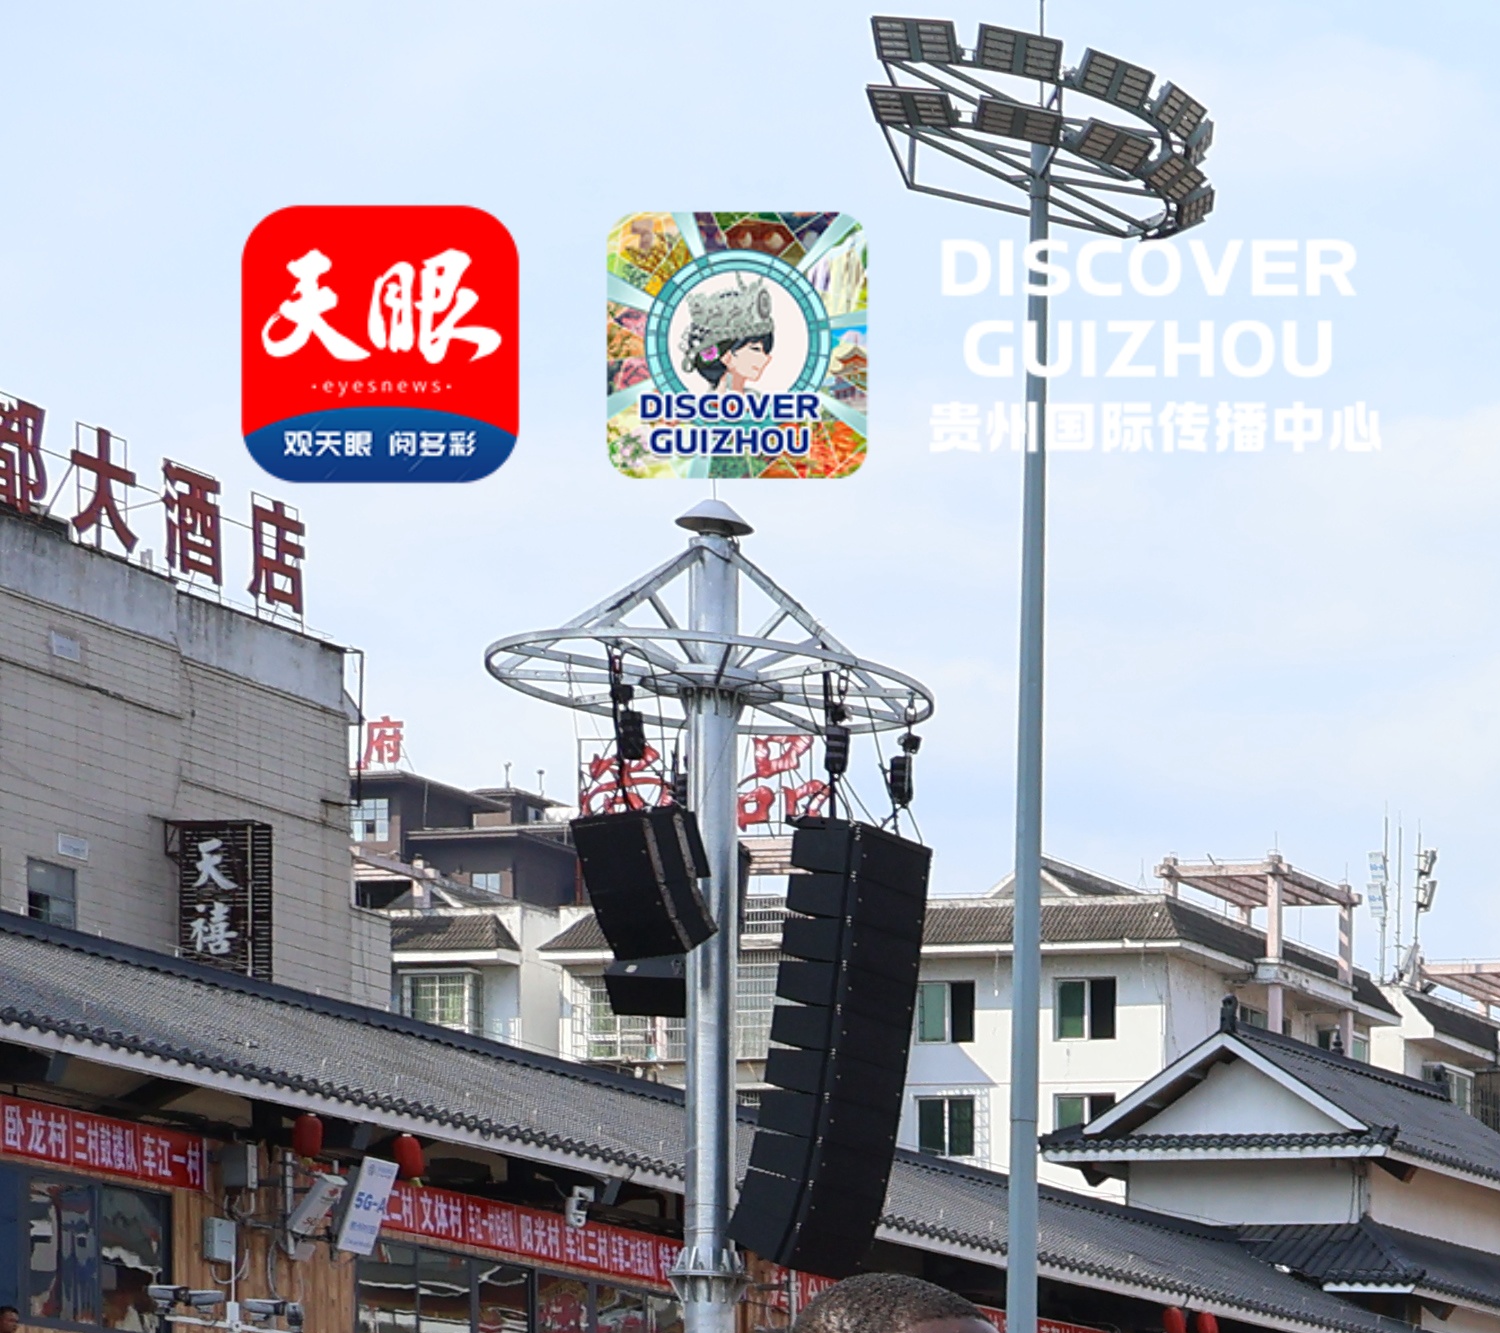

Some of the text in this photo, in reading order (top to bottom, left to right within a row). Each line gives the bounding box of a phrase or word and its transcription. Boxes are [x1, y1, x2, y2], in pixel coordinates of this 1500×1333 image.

[0, 398, 306, 615] 都大酒店
[364, 716, 403, 770] 府
[190, 839, 237, 956] 天禧
[5, 1105, 67, 1159] 卧龙村
[142, 1133, 200, 1186] 车江一村
